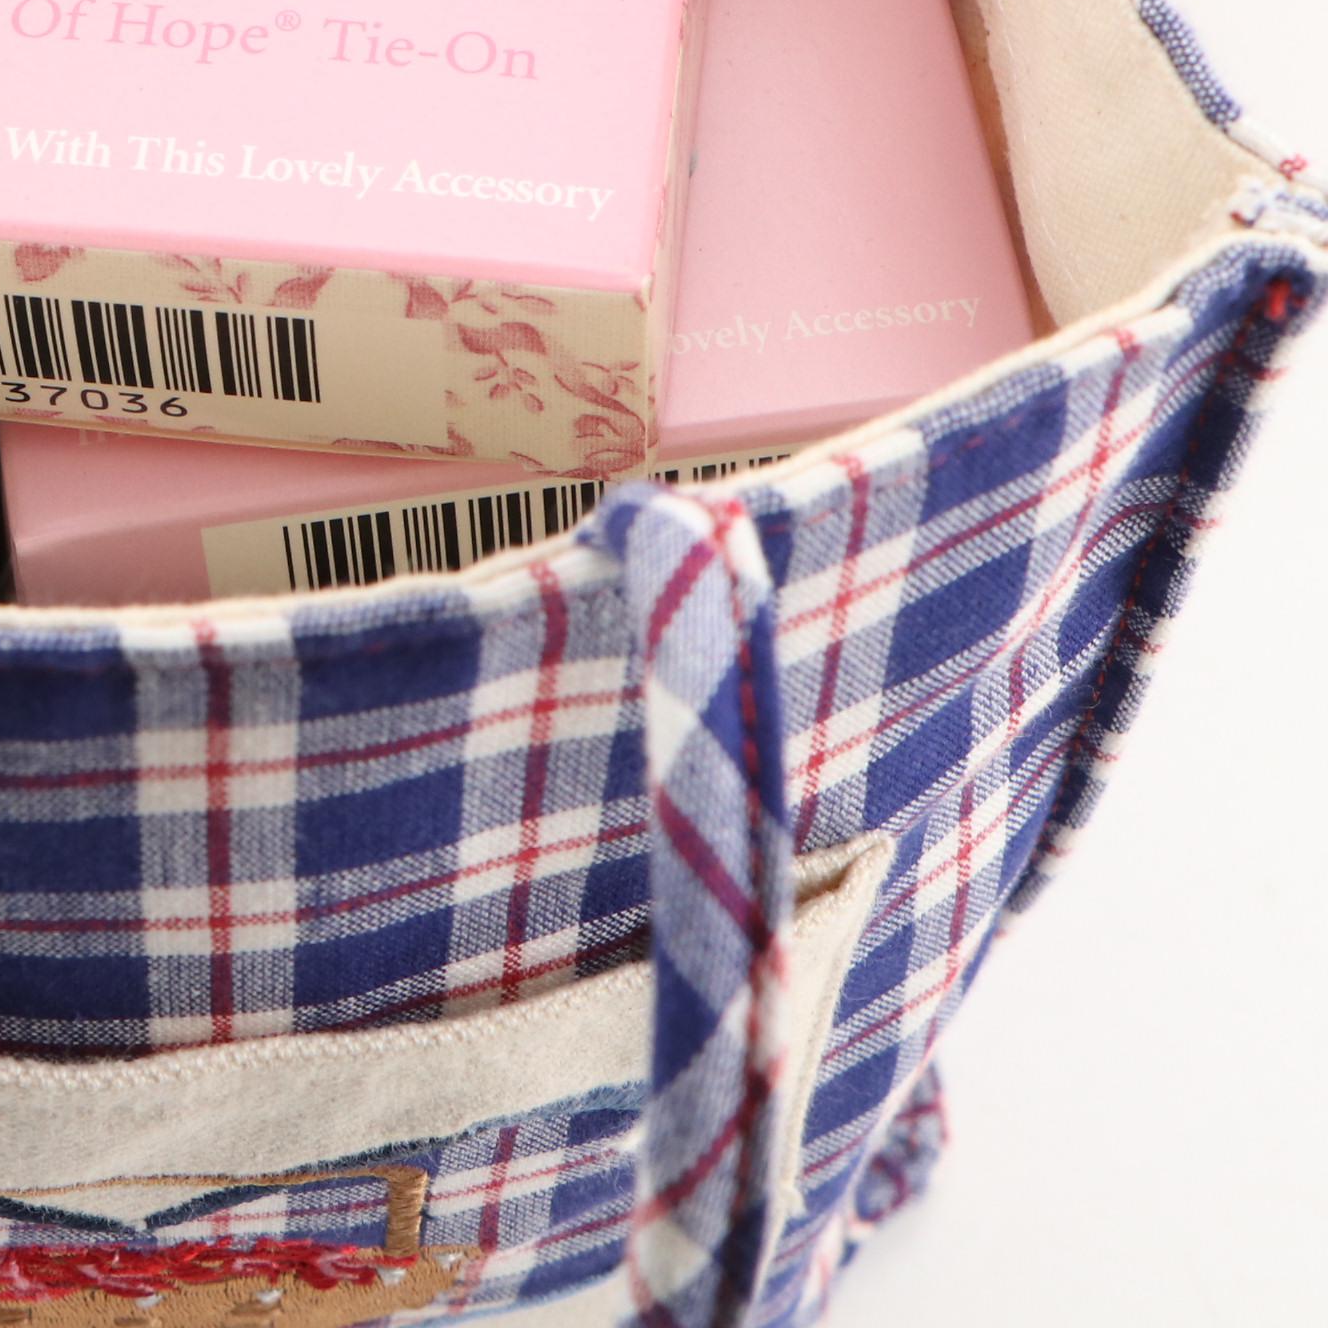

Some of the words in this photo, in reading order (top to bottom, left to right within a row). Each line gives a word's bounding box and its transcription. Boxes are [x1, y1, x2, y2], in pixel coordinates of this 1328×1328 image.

[322, 18, 538, 80] Tie-On
[5, 127, 112, 169] With
[128, 135, 225, 177] This
[238, 145, 384, 200] Lovely
[393, 160, 615, 221] Accessory
[672, 315, 769, 355] ovely
[785, 297, 981, 340] Accessory
[1, 381, 188, 418] 37036
